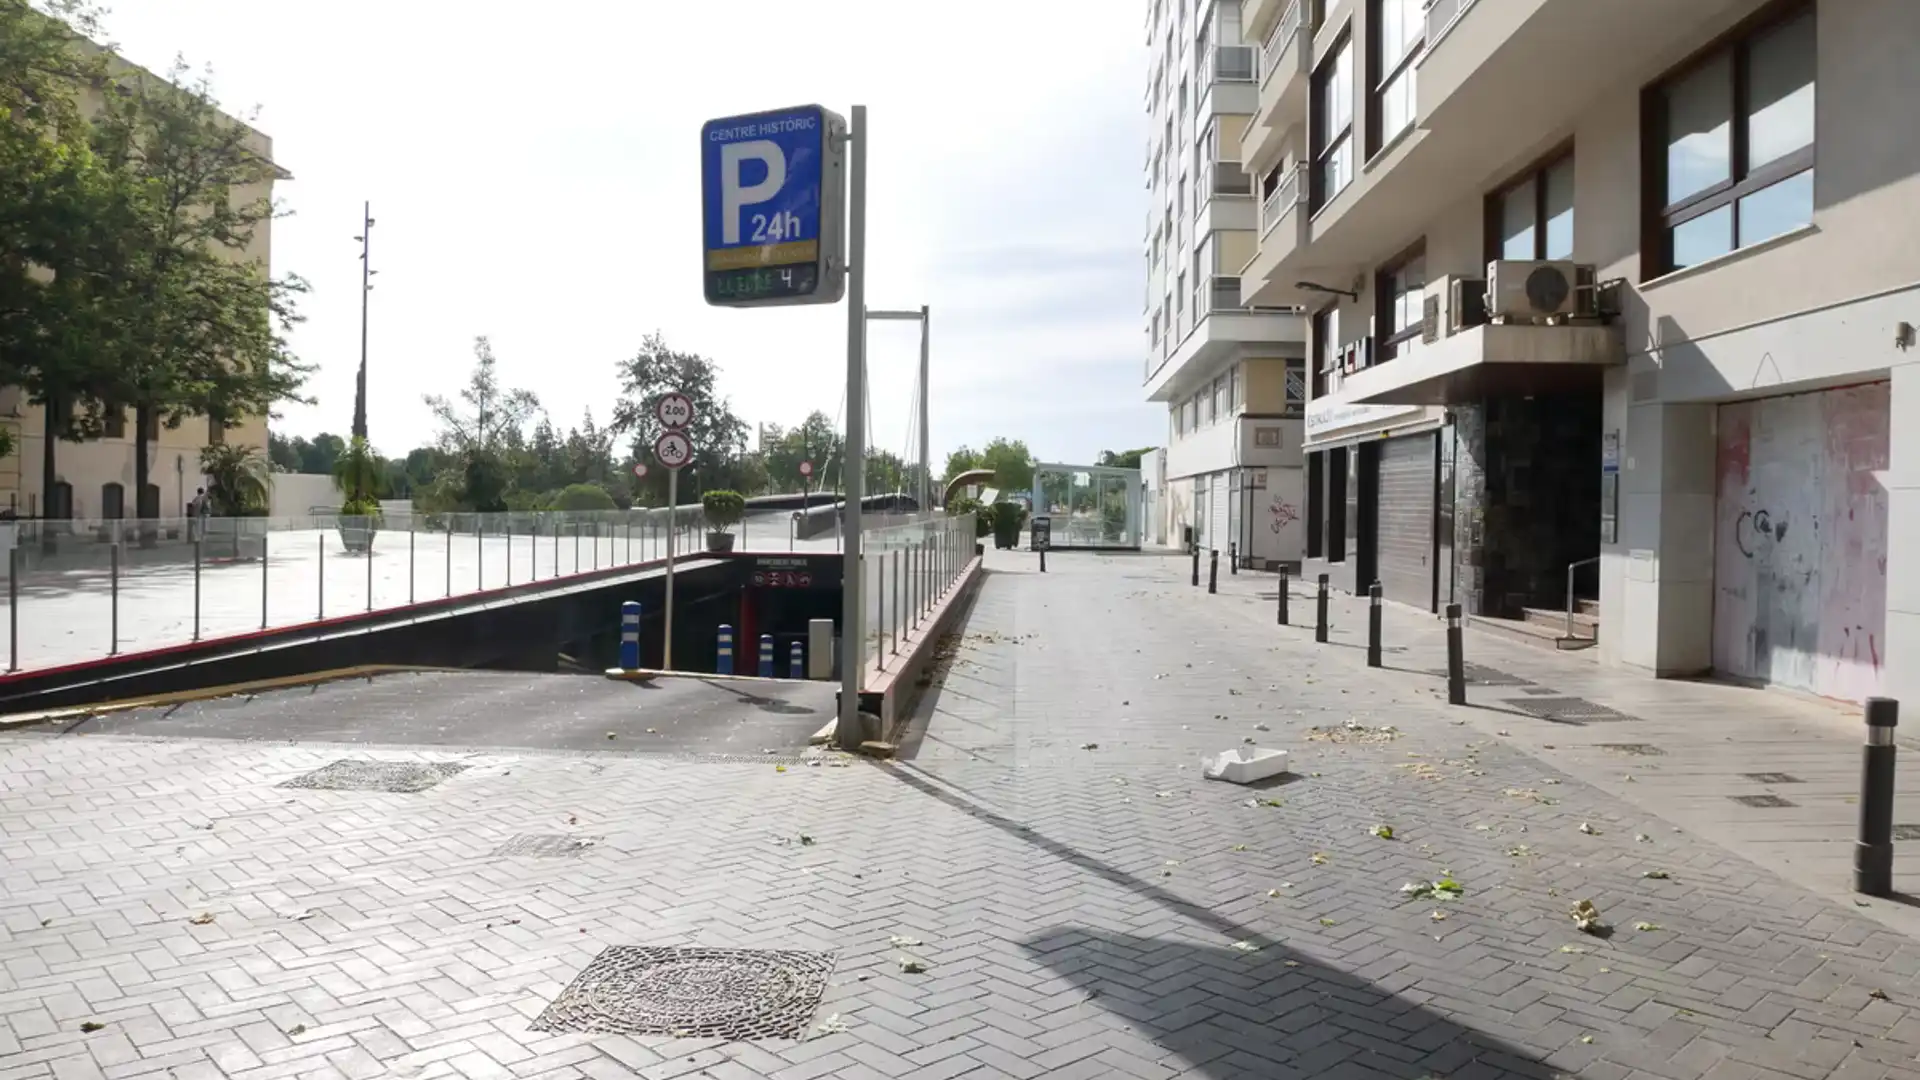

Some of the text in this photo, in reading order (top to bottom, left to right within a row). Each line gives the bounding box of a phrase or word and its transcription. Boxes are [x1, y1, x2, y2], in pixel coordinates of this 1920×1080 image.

[710, 125, 757, 142] CENTRE
[721, 139, 787, 244] P
[751, 211, 800, 242] 24h
